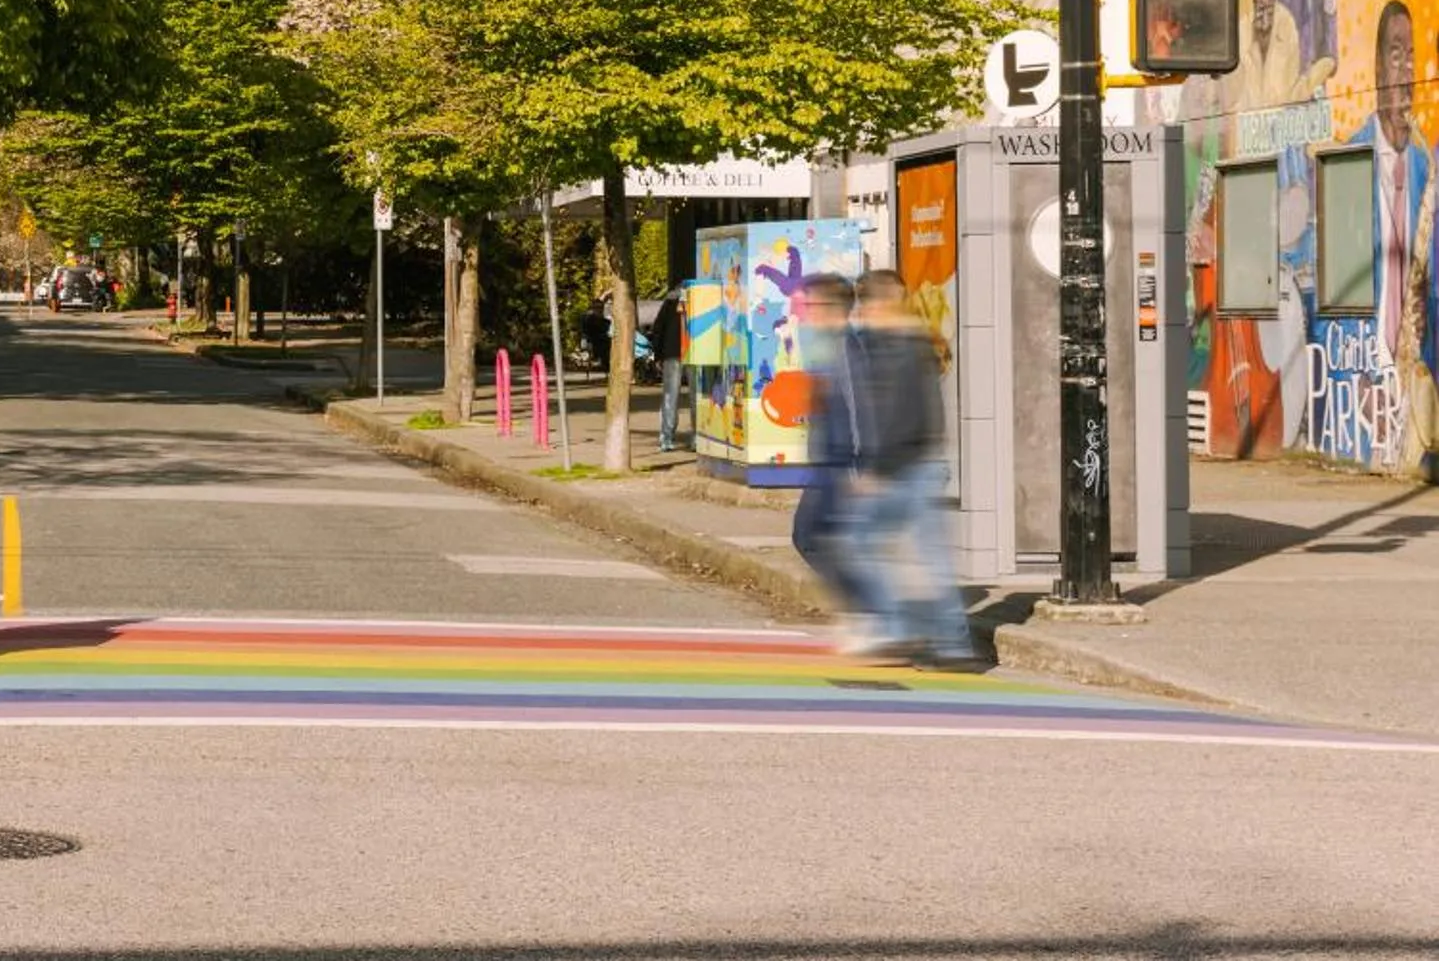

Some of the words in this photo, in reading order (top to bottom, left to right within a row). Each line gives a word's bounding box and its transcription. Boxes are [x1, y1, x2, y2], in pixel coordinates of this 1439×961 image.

[724, 173, 763, 187] DELI
[1326, 320, 1380, 373] Charlie
[1305, 342, 1402, 465] PARKER
